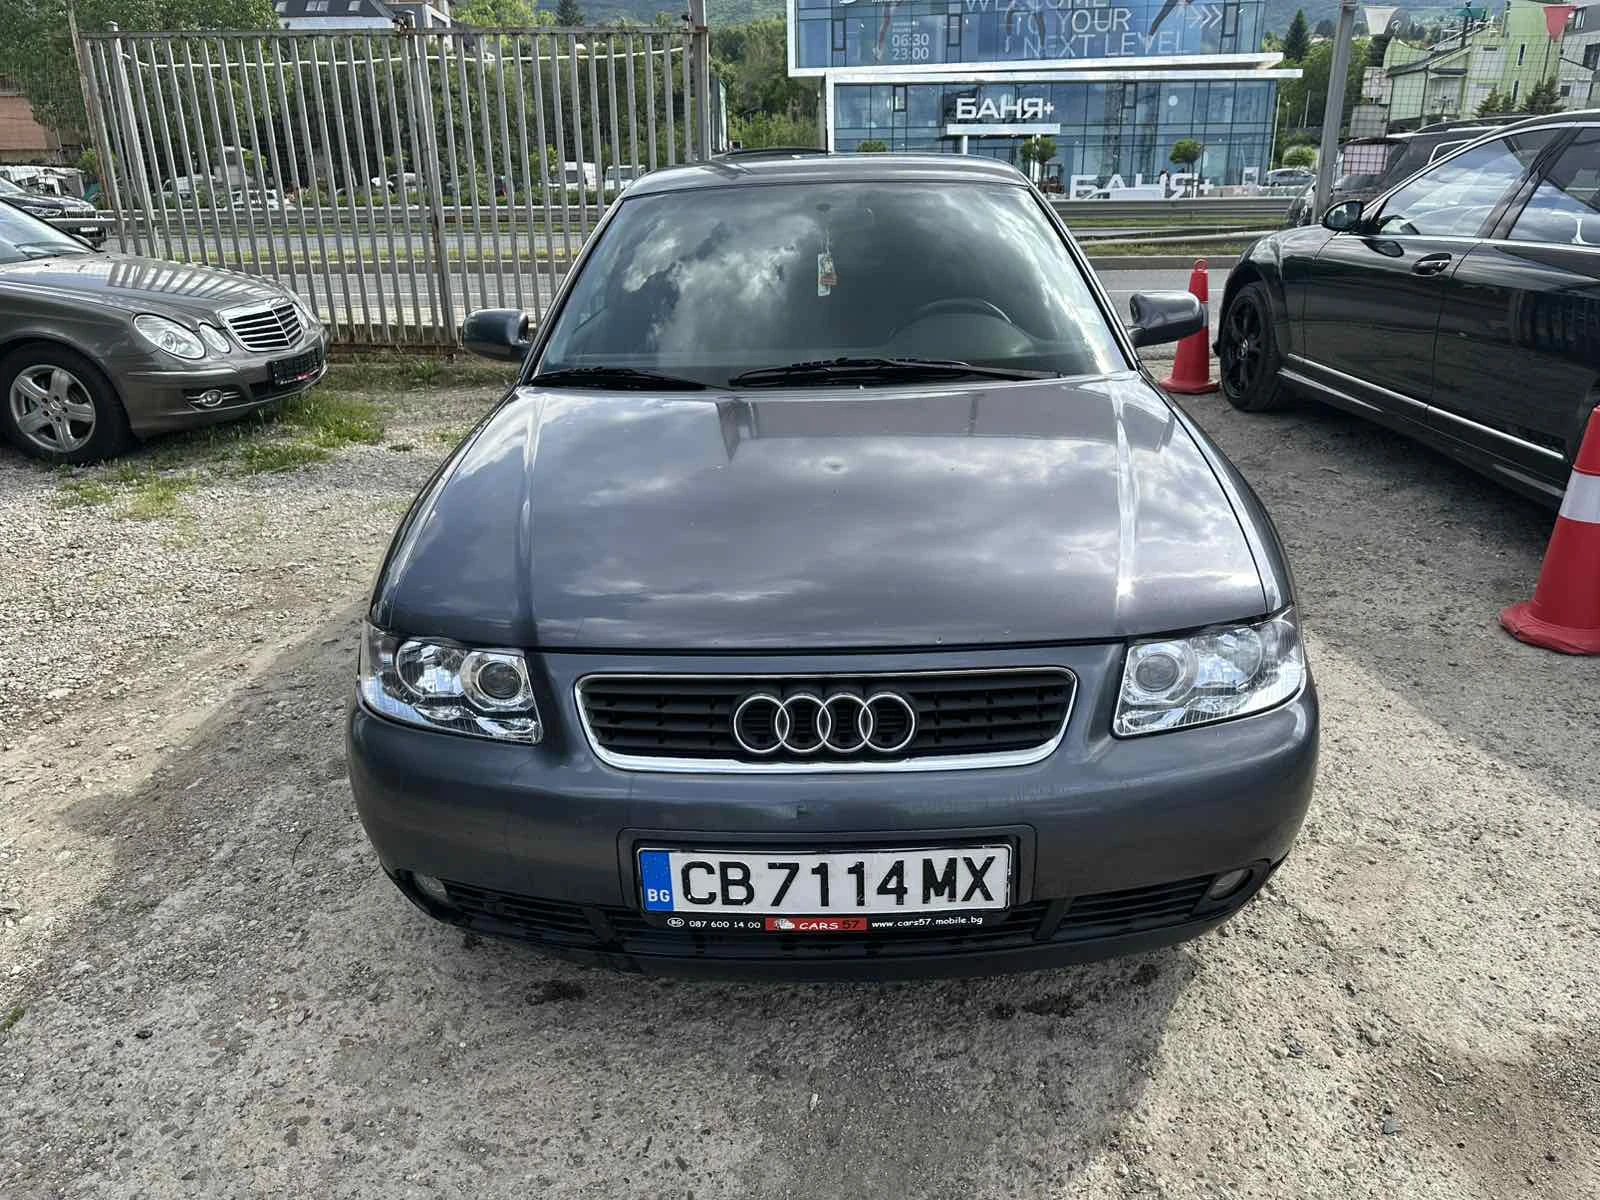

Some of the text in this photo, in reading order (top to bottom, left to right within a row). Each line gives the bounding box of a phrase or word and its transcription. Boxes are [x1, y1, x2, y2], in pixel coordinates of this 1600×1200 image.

[1057, 8, 1133, 34] YOUR
[892, 33, 930, 46] 06:30
[1023, 34, 1096, 59] NEXT
[892, 47, 930, 61] 23:00
[680, 855, 996, 907] CB 7114 MX
[647, 889, 670, 902] BG
[688, 920, 708, 928] 087
[710, 920, 731, 929] 600
[733, 921, 745, 929] 14
[747, 921, 762, 929] 00
[799, 920, 861, 930] CARS 57
